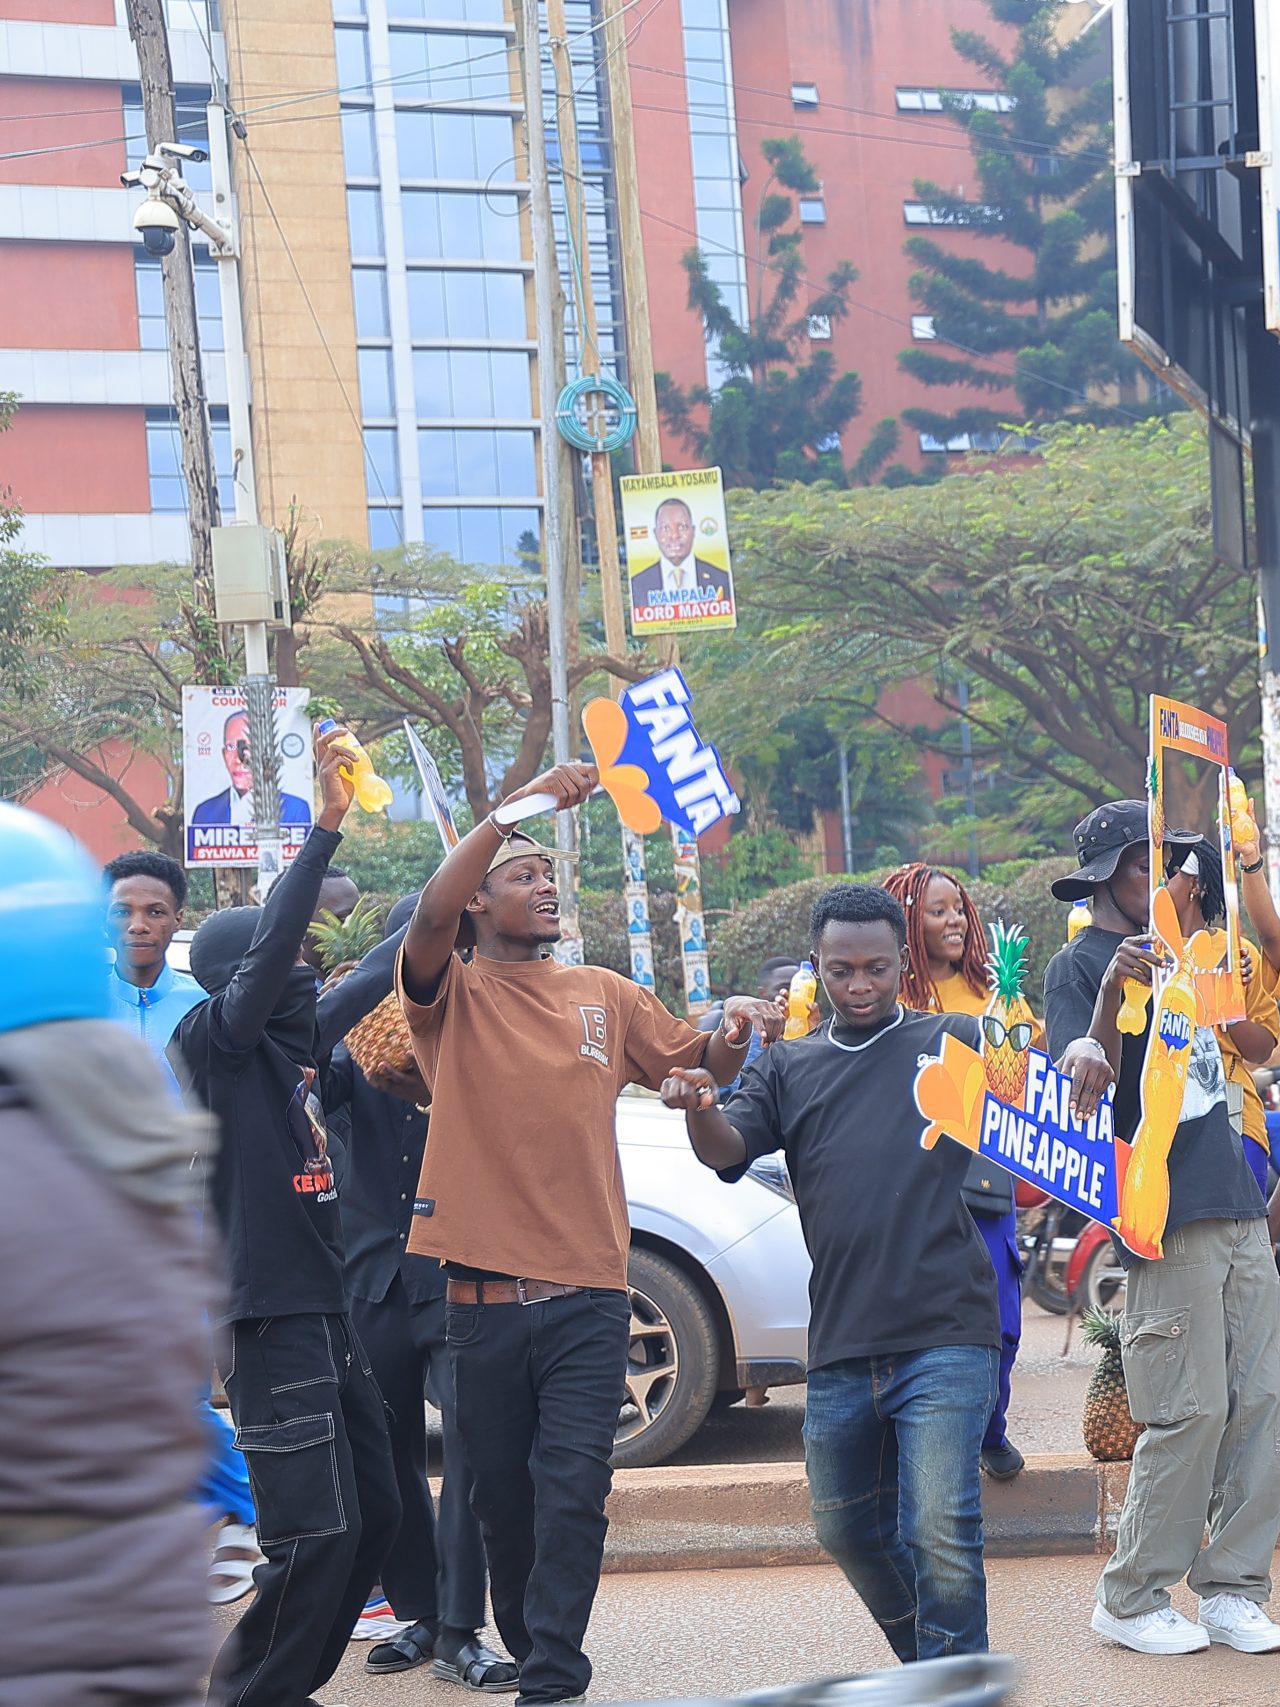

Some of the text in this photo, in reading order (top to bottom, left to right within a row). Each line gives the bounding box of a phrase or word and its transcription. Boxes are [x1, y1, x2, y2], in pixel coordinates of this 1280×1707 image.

[681, 470, 718, 488] YOSAMU
[648, 586, 716, 606] KAMPALA
[634, 601, 731, 621] LORD MAYOR
[1160, 708, 1179, 740] FANTA
[626, 668, 733, 836] FANTA
[197, 848, 246, 859] SYLIVIA
[1160, 1008, 1190, 1041] FANTA
[983, 1099, 1106, 1209] PINEAPPLE
